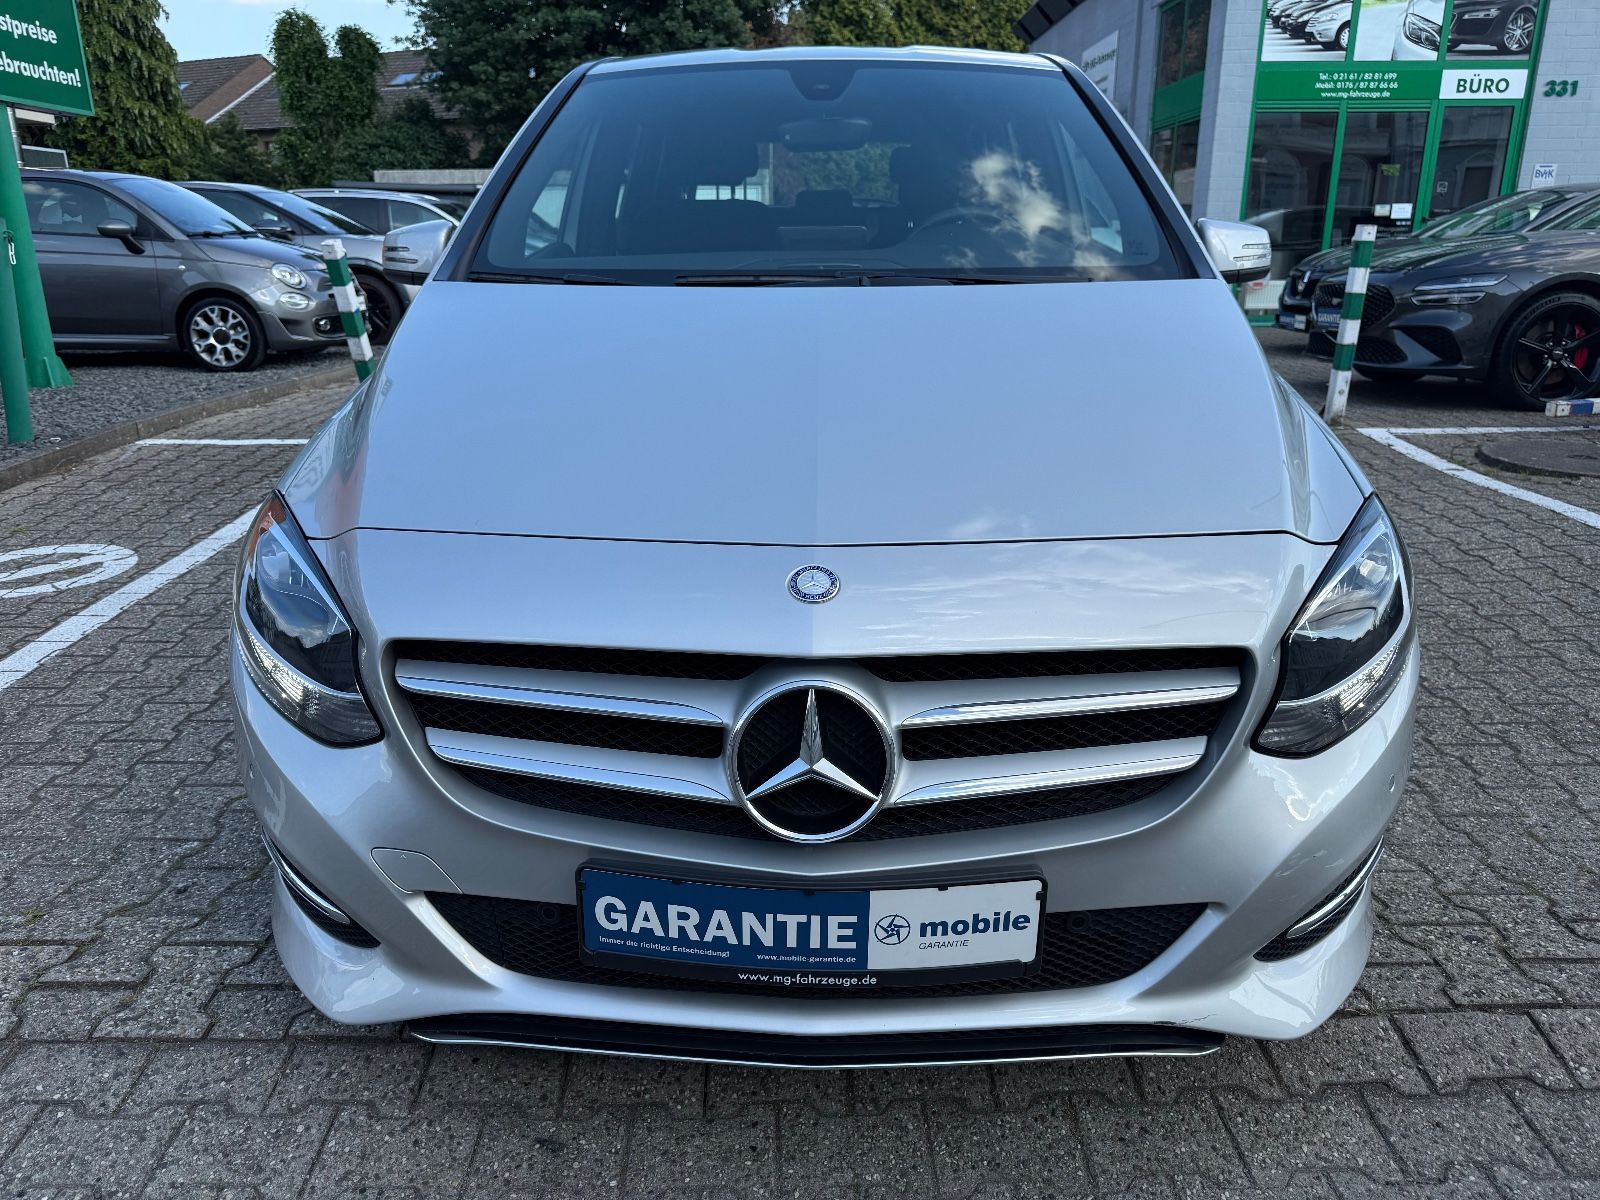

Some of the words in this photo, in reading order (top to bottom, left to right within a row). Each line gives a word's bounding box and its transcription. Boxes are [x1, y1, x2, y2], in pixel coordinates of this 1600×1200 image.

[1455, 73, 1510, 94] BÜRO
[1543, 80, 1579, 97] 331
[594, 895, 858, 949] GARANTIE
[919, 910, 1031, 938] mobile
[599, 935, 625, 945] Immer
[626, 939, 638, 947] die
[640, 941, 671, 952] richtige
[672, 945, 730, 958] Entscheidung!
[918, 939, 970, 950] GARANTIE
[756, 954, 857, 964] www.mobile-garantie.de
[738, 972, 877, 987] www.mg-fahrzeuge.de
